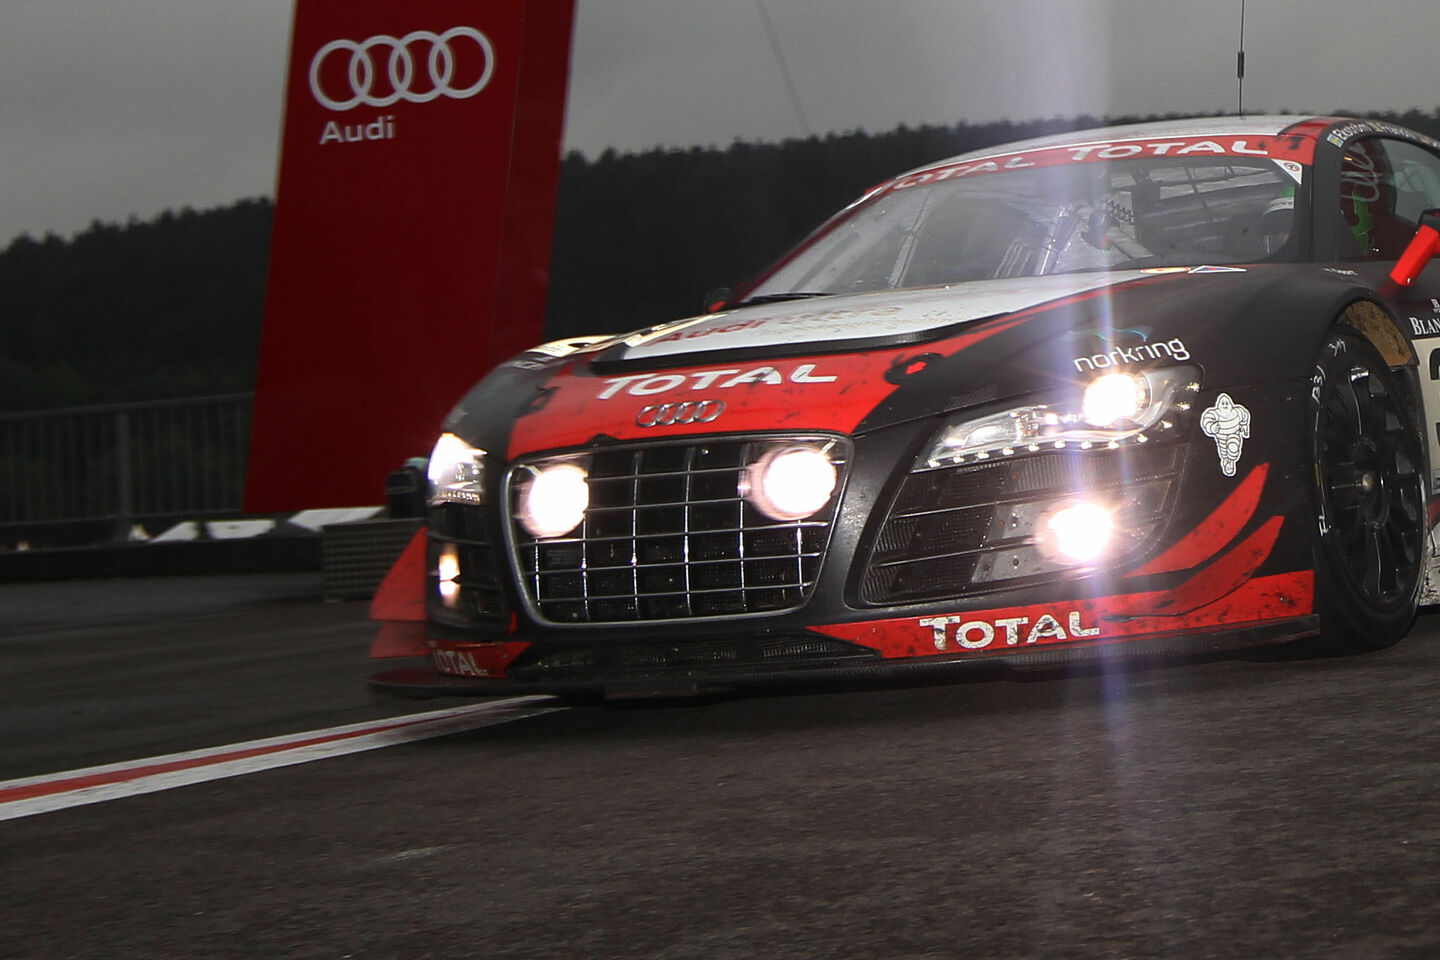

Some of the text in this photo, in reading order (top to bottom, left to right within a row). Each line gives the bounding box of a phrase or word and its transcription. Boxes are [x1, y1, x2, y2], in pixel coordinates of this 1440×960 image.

[319, 115, 396, 145] Audi
[1067, 139, 1269, 162] TOTAL
[1073, 337, 1191, 373] norkring
[597, 363, 838, 401] TOTAL
[919, 610, 1100, 651] TOTAL
